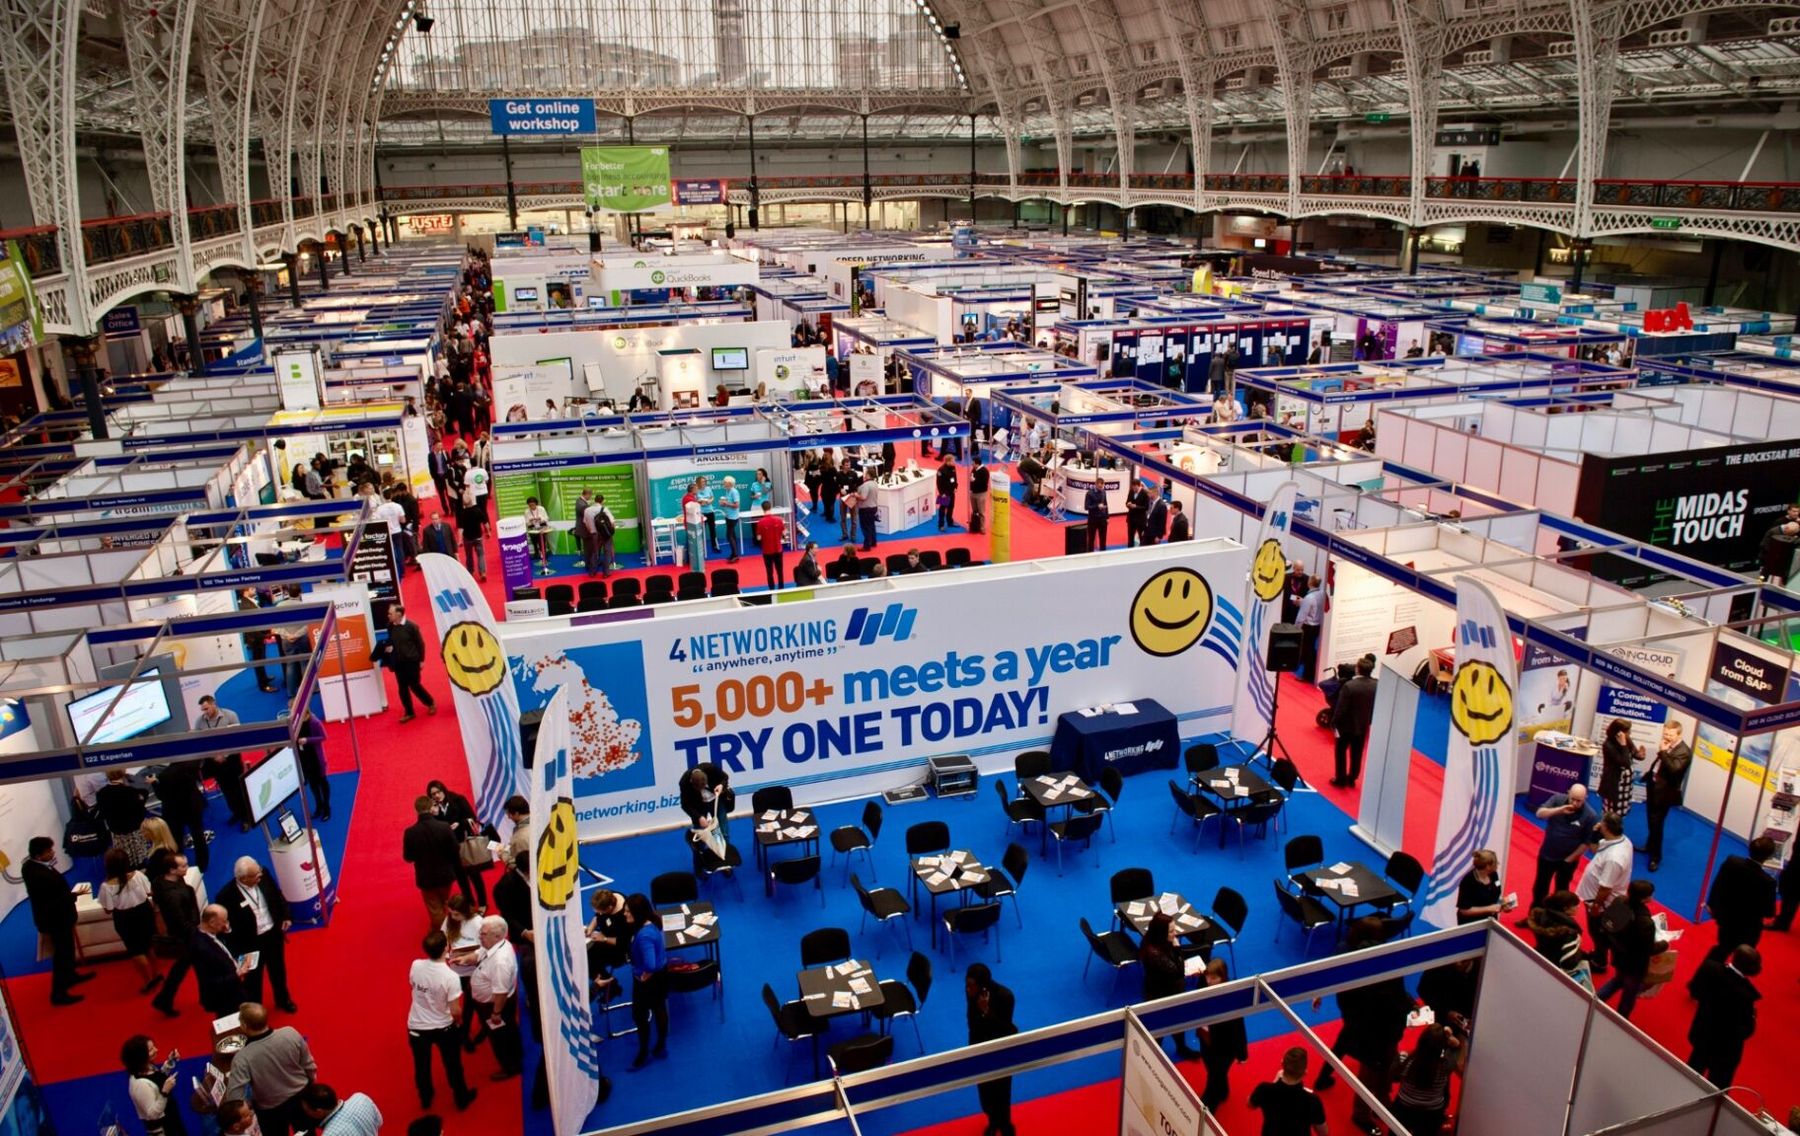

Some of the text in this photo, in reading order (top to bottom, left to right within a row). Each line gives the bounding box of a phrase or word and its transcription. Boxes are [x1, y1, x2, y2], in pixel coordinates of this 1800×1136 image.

[506, 101, 579, 114] Get online
[509, 118, 579, 132] workshop
[600, 162, 625, 170] better
[587, 183, 627, 197] Start
[408, 215, 438, 230] JUST
[667, 274, 711, 284] QuickBooks
[1251, 266, 1270, 280] Speed
[108, 312, 131, 321] Sales
[108, 320, 135, 329] Office
[1725, 454, 1742, 466] THE
[1743, 450, 1787, 463] ROCKSTAR
[1676, 488, 1749, 520] MIDAS
[1753, 504, 1781, 515] SPONSORED
[1672, 513, 1745, 546] TOUCH
[1531, 654, 1551, 666] from
[1626, 649, 1674, 664] INCLOUD
[843, 633, 1122, 704] meets a year
[1720, 665, 1745, 683] from
[1734, 658, 1764, 678] Cloud
[1613, 666, 1632, 679] CLOUD
[1632, 674, 1664, 693] SOLUTIONS
[1664, 688, 1687, 703] LIMITED
[671, 669, 833, 735] 5,000+
[1612, 698, 1652, 712] Business
[1766, 713, 1784, 723] CLOUD
[674, 685, 1049, 775] TRY ONE TODAY!
[85, 751, 133, 763] 122 Experian
